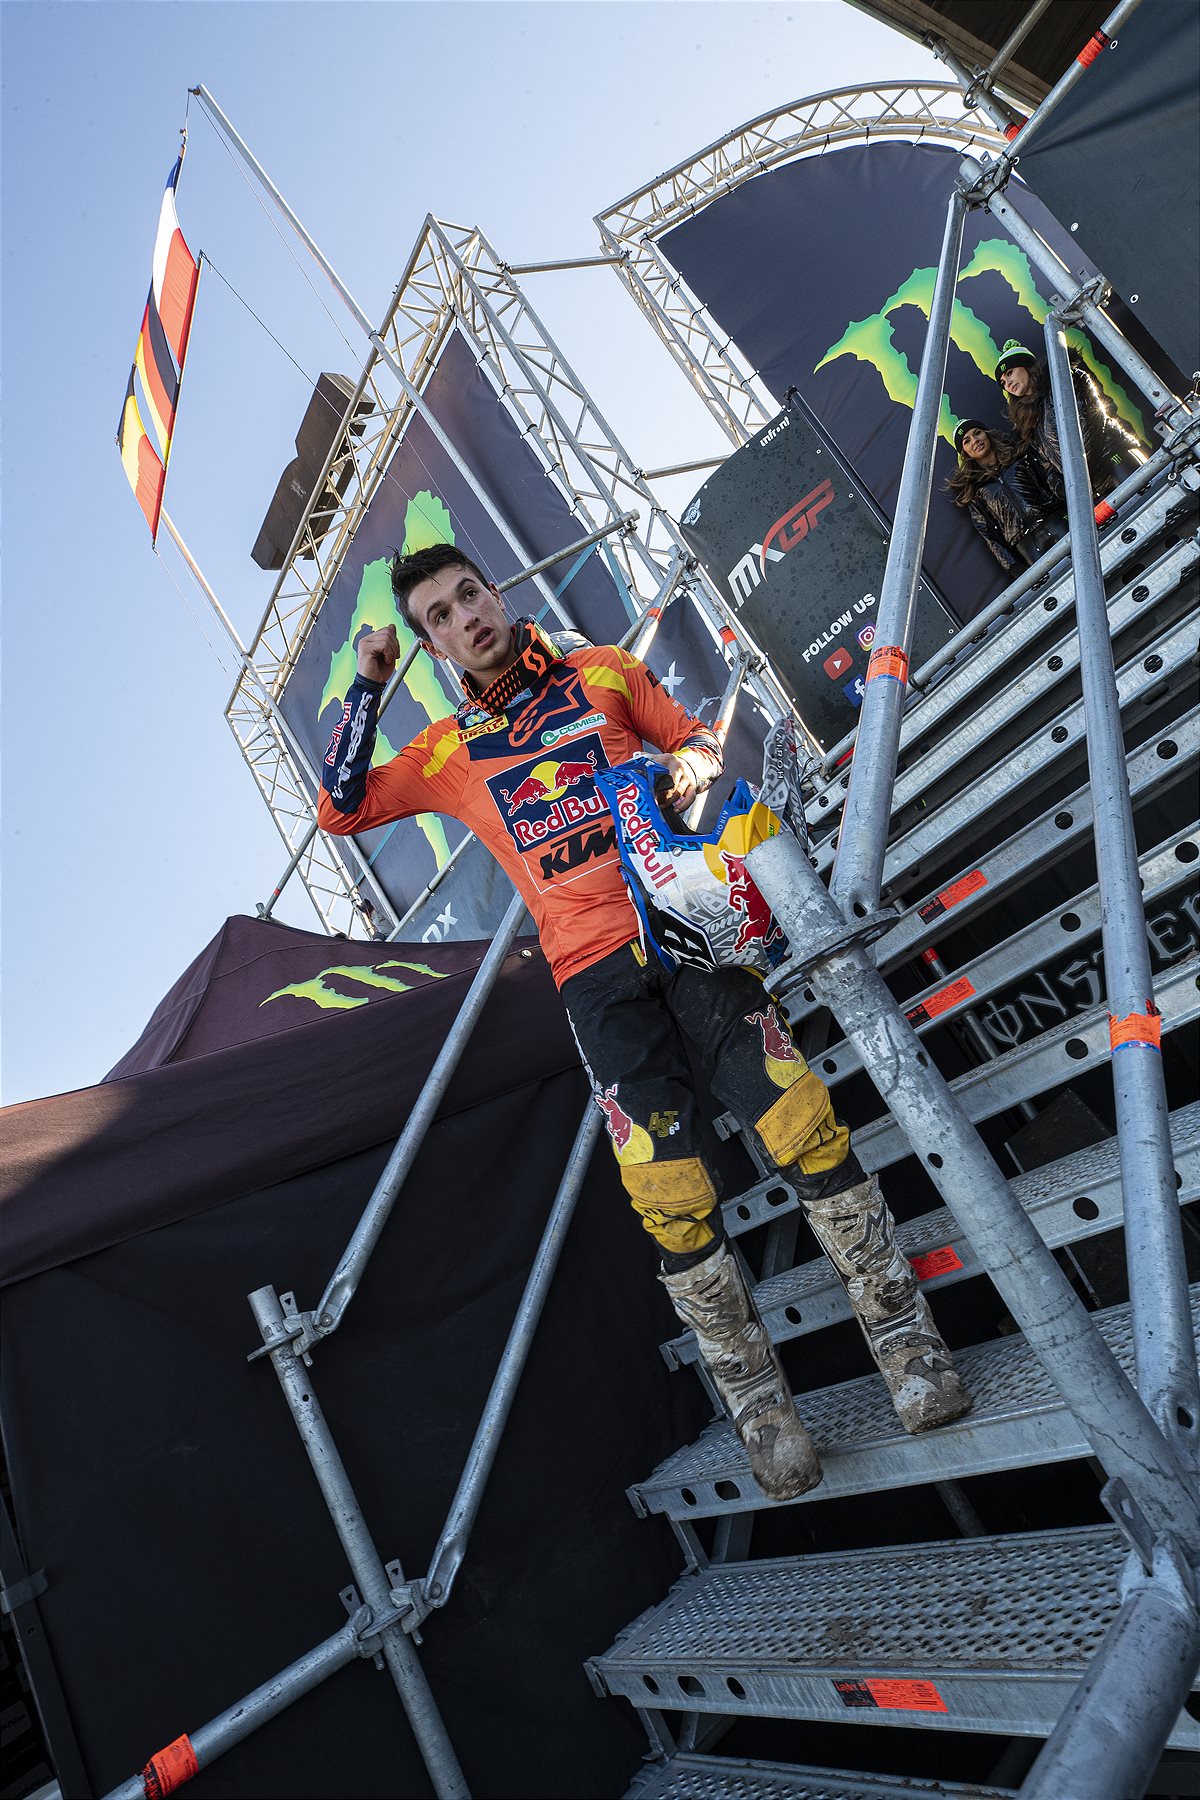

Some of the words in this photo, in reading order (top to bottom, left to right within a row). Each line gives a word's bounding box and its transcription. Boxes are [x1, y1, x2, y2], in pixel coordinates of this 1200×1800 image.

[727, 477, 836, 608] MXGP
[801, 609, 854, 663] FOLLOW
[852, 593, 876, 614] US
[559, 713, 606, 735] COMISA
[513, 801, 567, 847] Red
[560, 785, 610, 825] Bul
[616, 782, 653, 840] Red
[715, 809, 729, 836] AIROH
[539, 822, 619, 881] KTM
[632, 829, 678, 890] Bull
